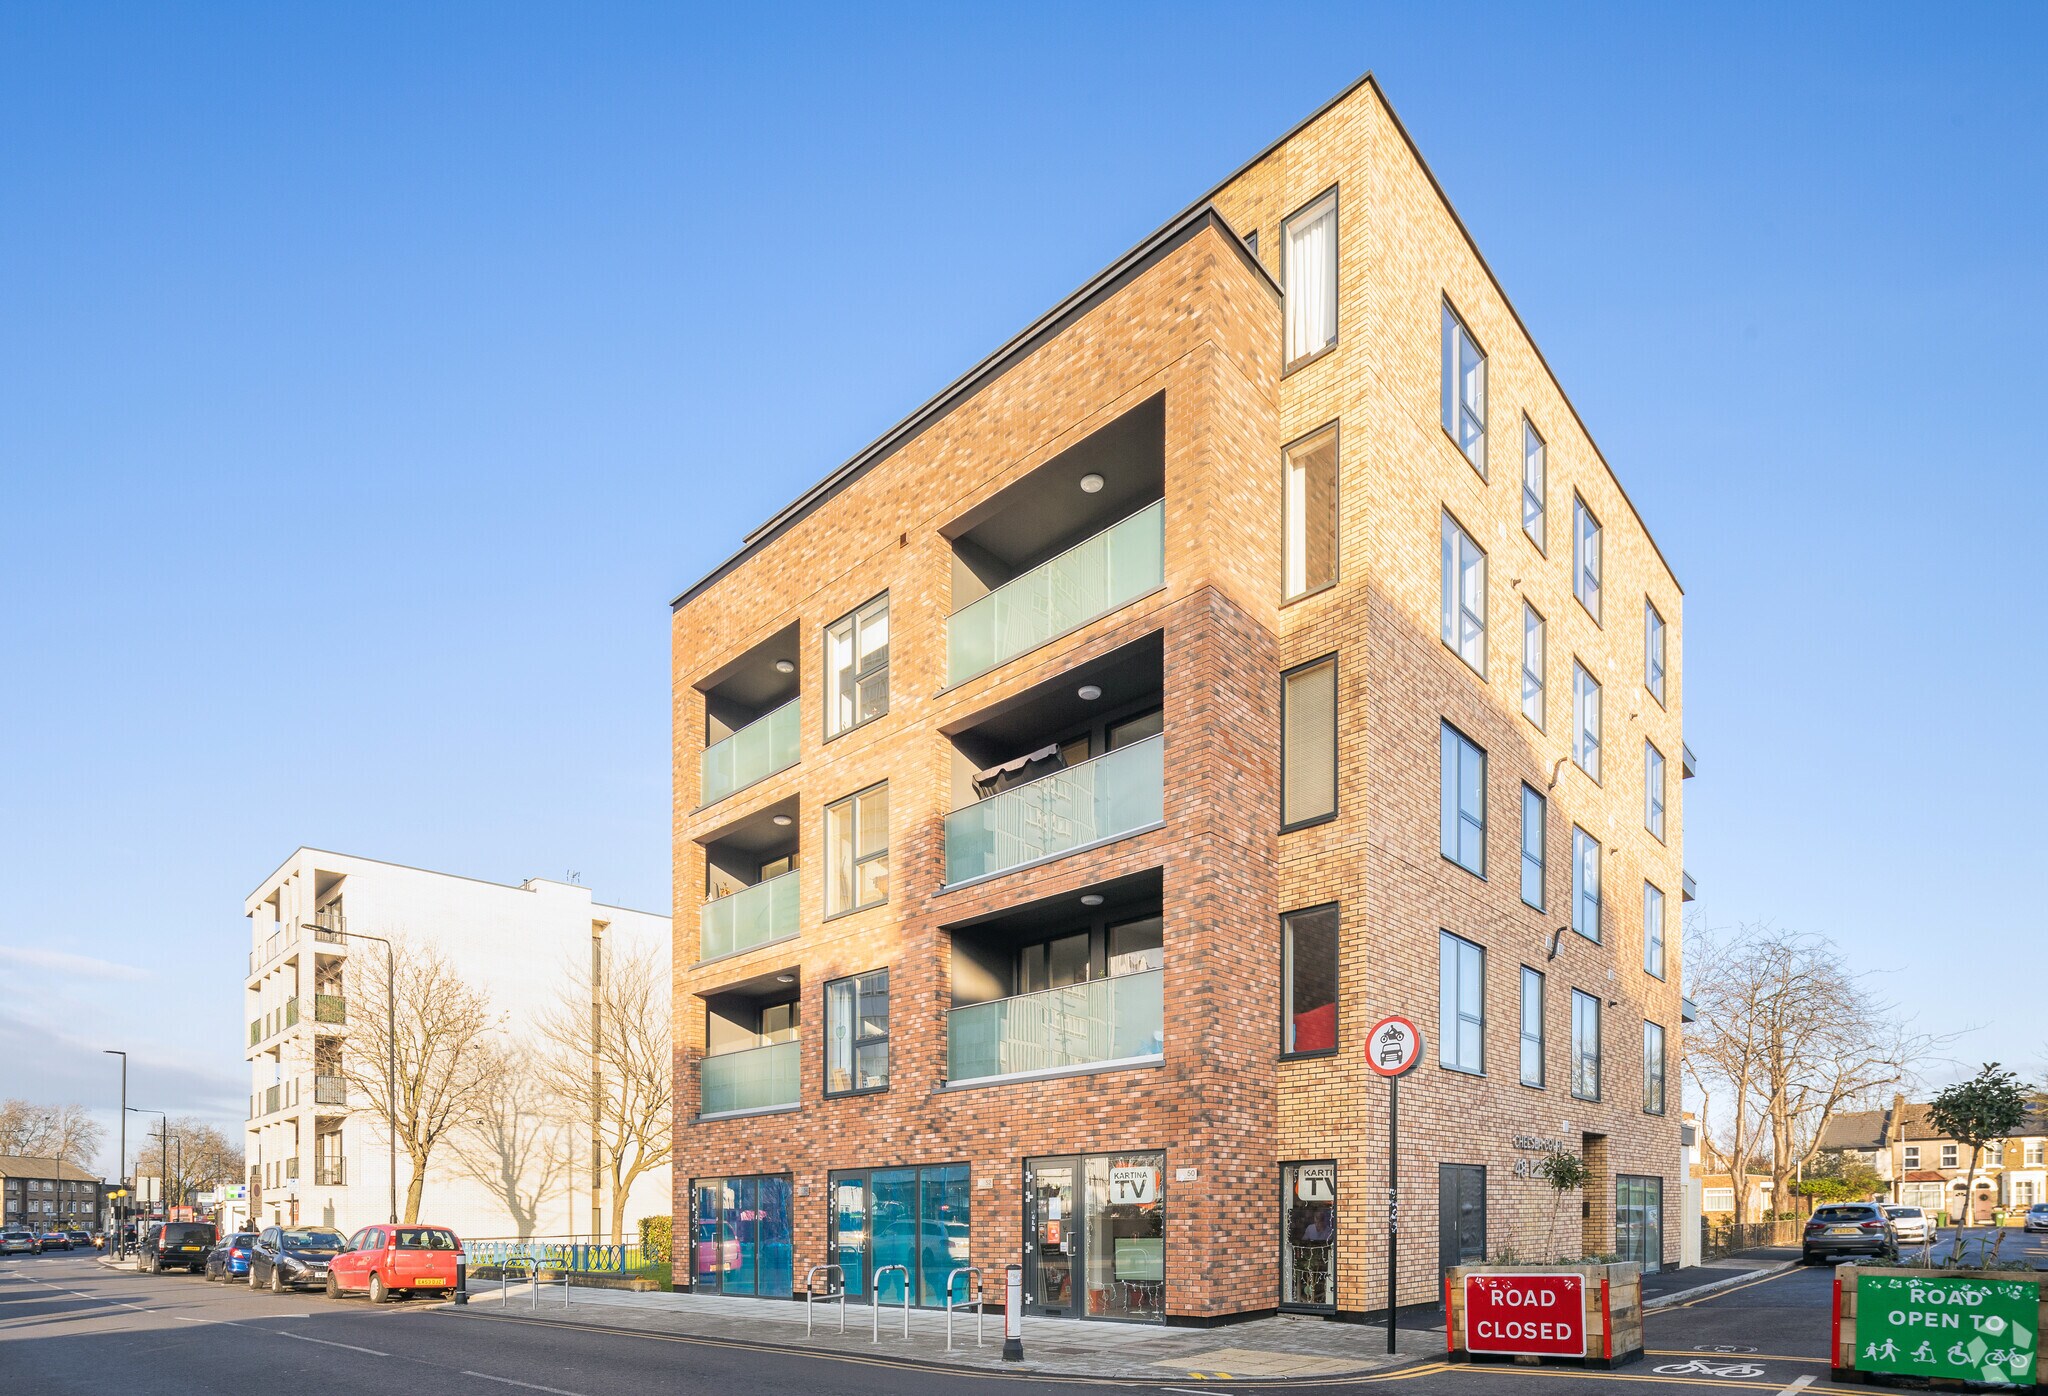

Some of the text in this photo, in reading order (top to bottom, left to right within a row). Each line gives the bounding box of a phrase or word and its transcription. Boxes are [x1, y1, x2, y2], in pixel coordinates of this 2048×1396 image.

[1514, 1134, 1543, 1151] CHELSEA
[1114, 1171, 1148, 1179] KARTINA
[1187, 1169, 1195, 1177] 50
[1515, 1158, 1526, 1178] 48
[1115, 1179, 1147, 1198] TV
[1491, 1289, 1556, 1307] ROAD
[1910, 1288, 1983, 1306] ROAD
[1888, 1310, 2005, 1331] OPEN TO
[1477, 1320, 1572, 1341] CLOSED
